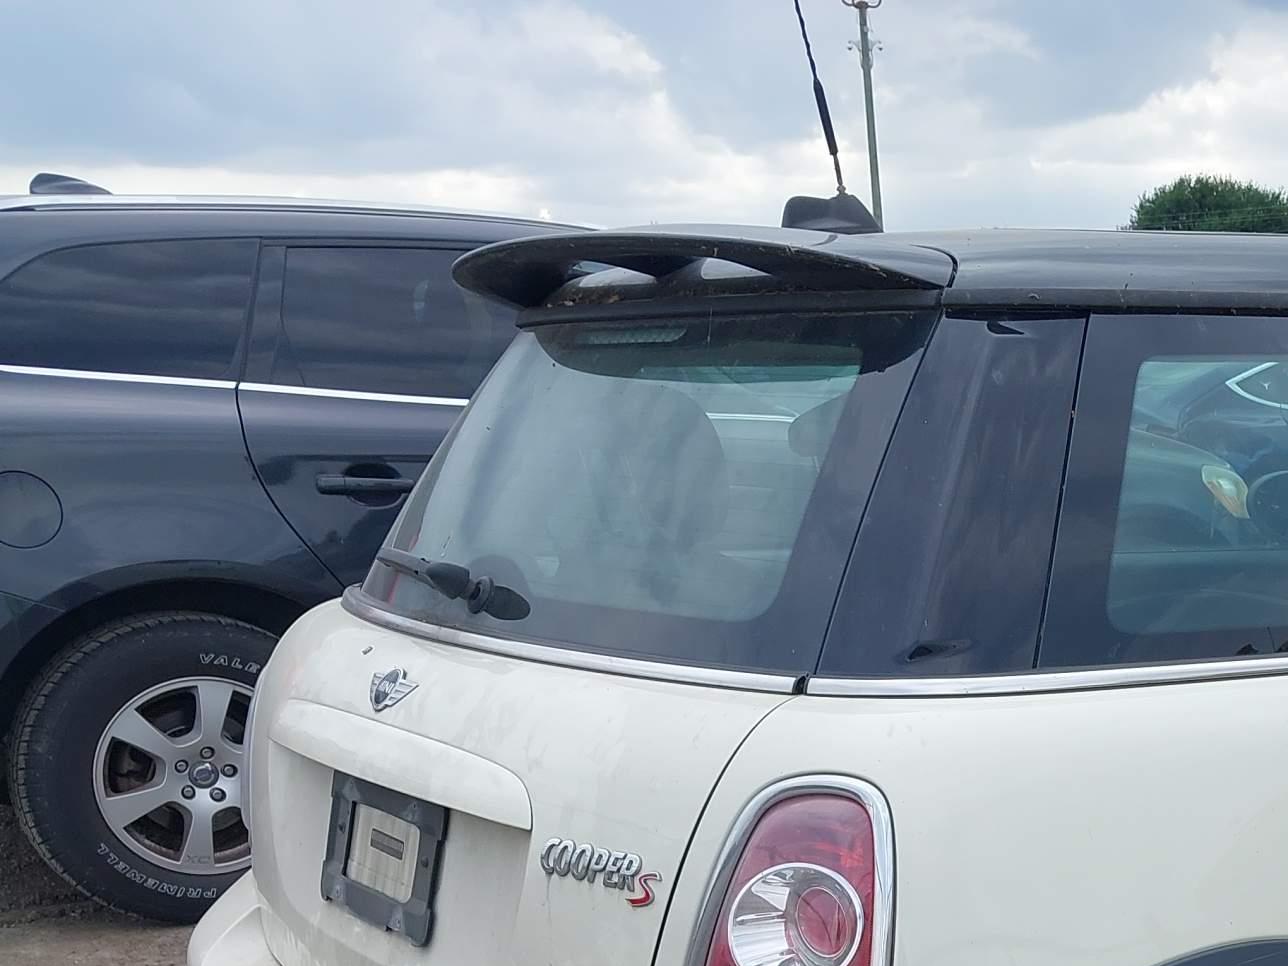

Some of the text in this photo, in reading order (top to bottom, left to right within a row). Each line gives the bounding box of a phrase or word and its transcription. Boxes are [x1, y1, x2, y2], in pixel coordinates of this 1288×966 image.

[97, 842, 217, 899] PRIMEWELL
[540, 837, 662, 908] COOPER S
